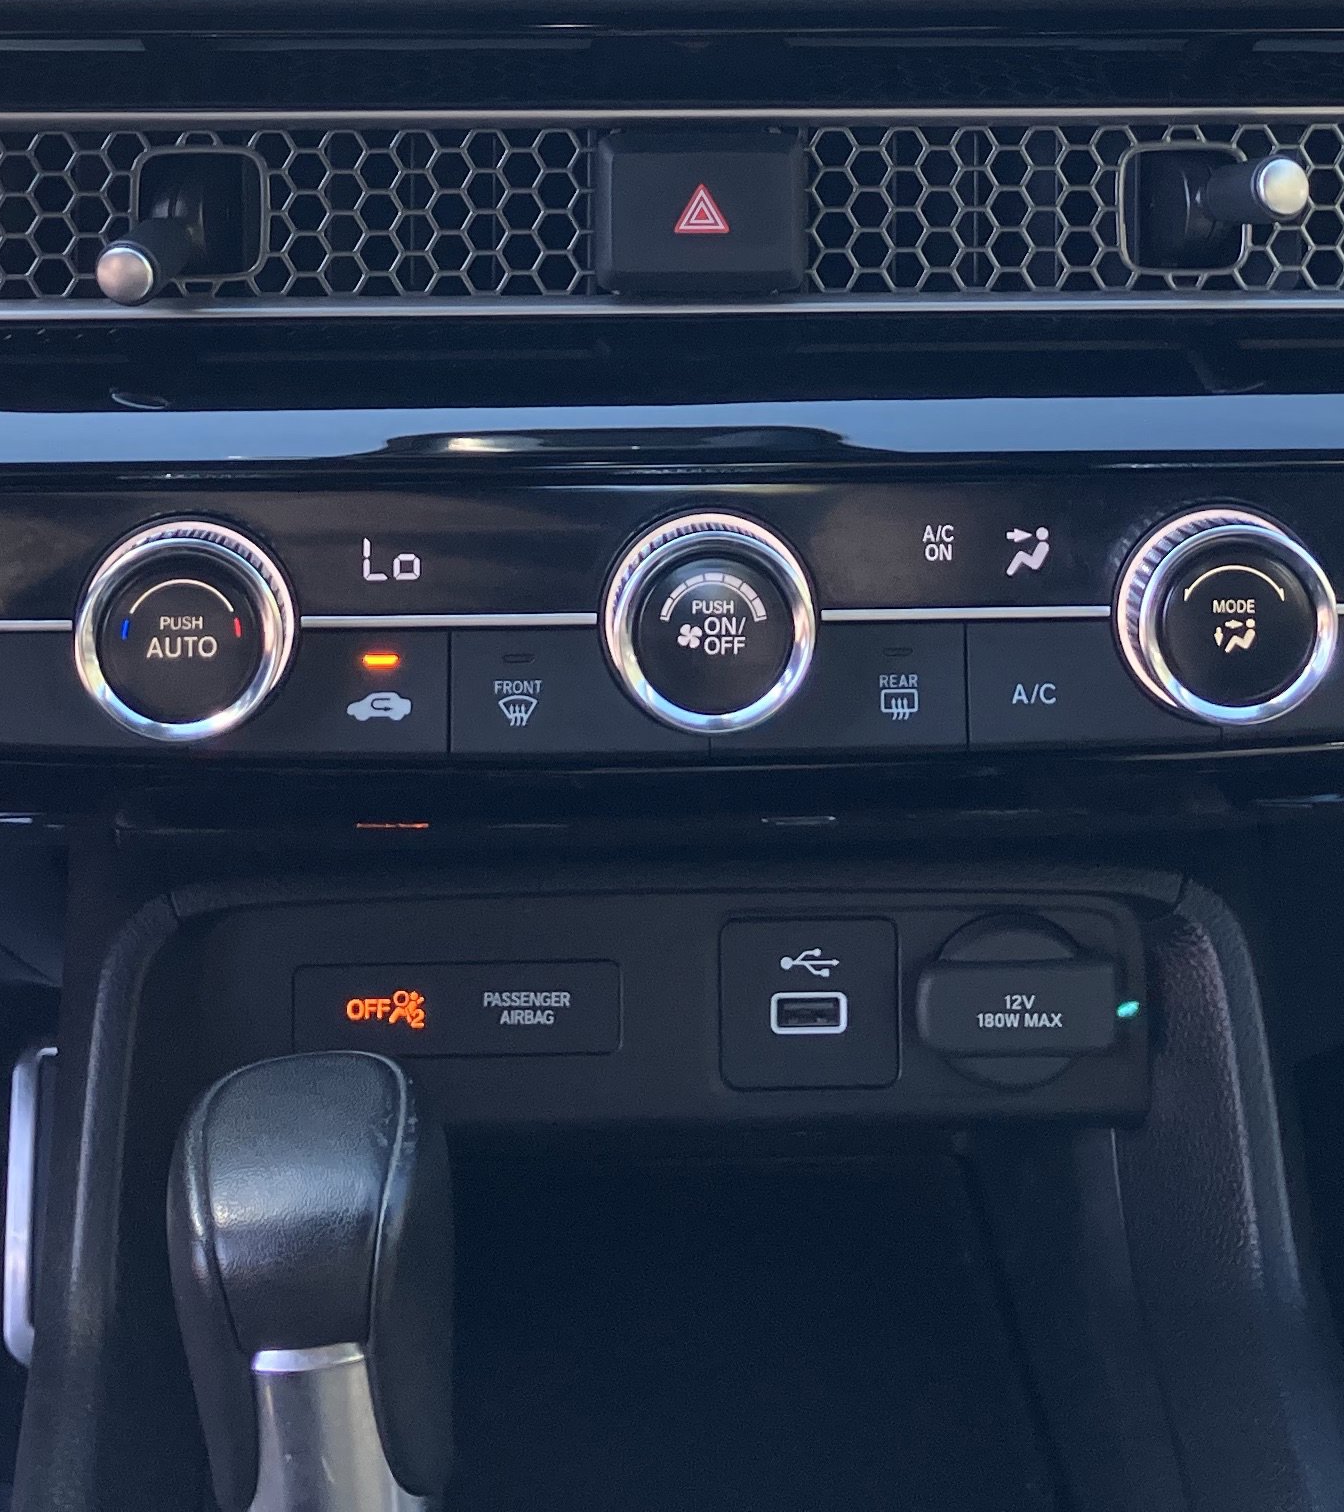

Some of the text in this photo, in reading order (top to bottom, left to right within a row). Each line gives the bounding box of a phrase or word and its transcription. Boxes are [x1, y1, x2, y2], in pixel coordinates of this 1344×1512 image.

[922, 524, 955, 543] A/C
[924, 543, 953, 562] ON
[692, 600, 734, 615] PUSH
[1212, 599, 1256, 614] MODE
[160, 615, 203, 630] PUSH
[147, 637, 218, 659] AUTO
[704, 636, 746, 655] OFF
[494, 679, 542, 694] FRONT
[879, 674, 919, 689] REAR
[1011, 683, 1057, 705] A/C
[483, 992, 571, 1008] PASSENGER
[1004, 995, 1036, 1010] 12V
[346, 998, 391, 1021] OFF
[500, 1010, 555, 1025] AIRBAG
[977, 1013, 1063, 1028] 180W MAX
